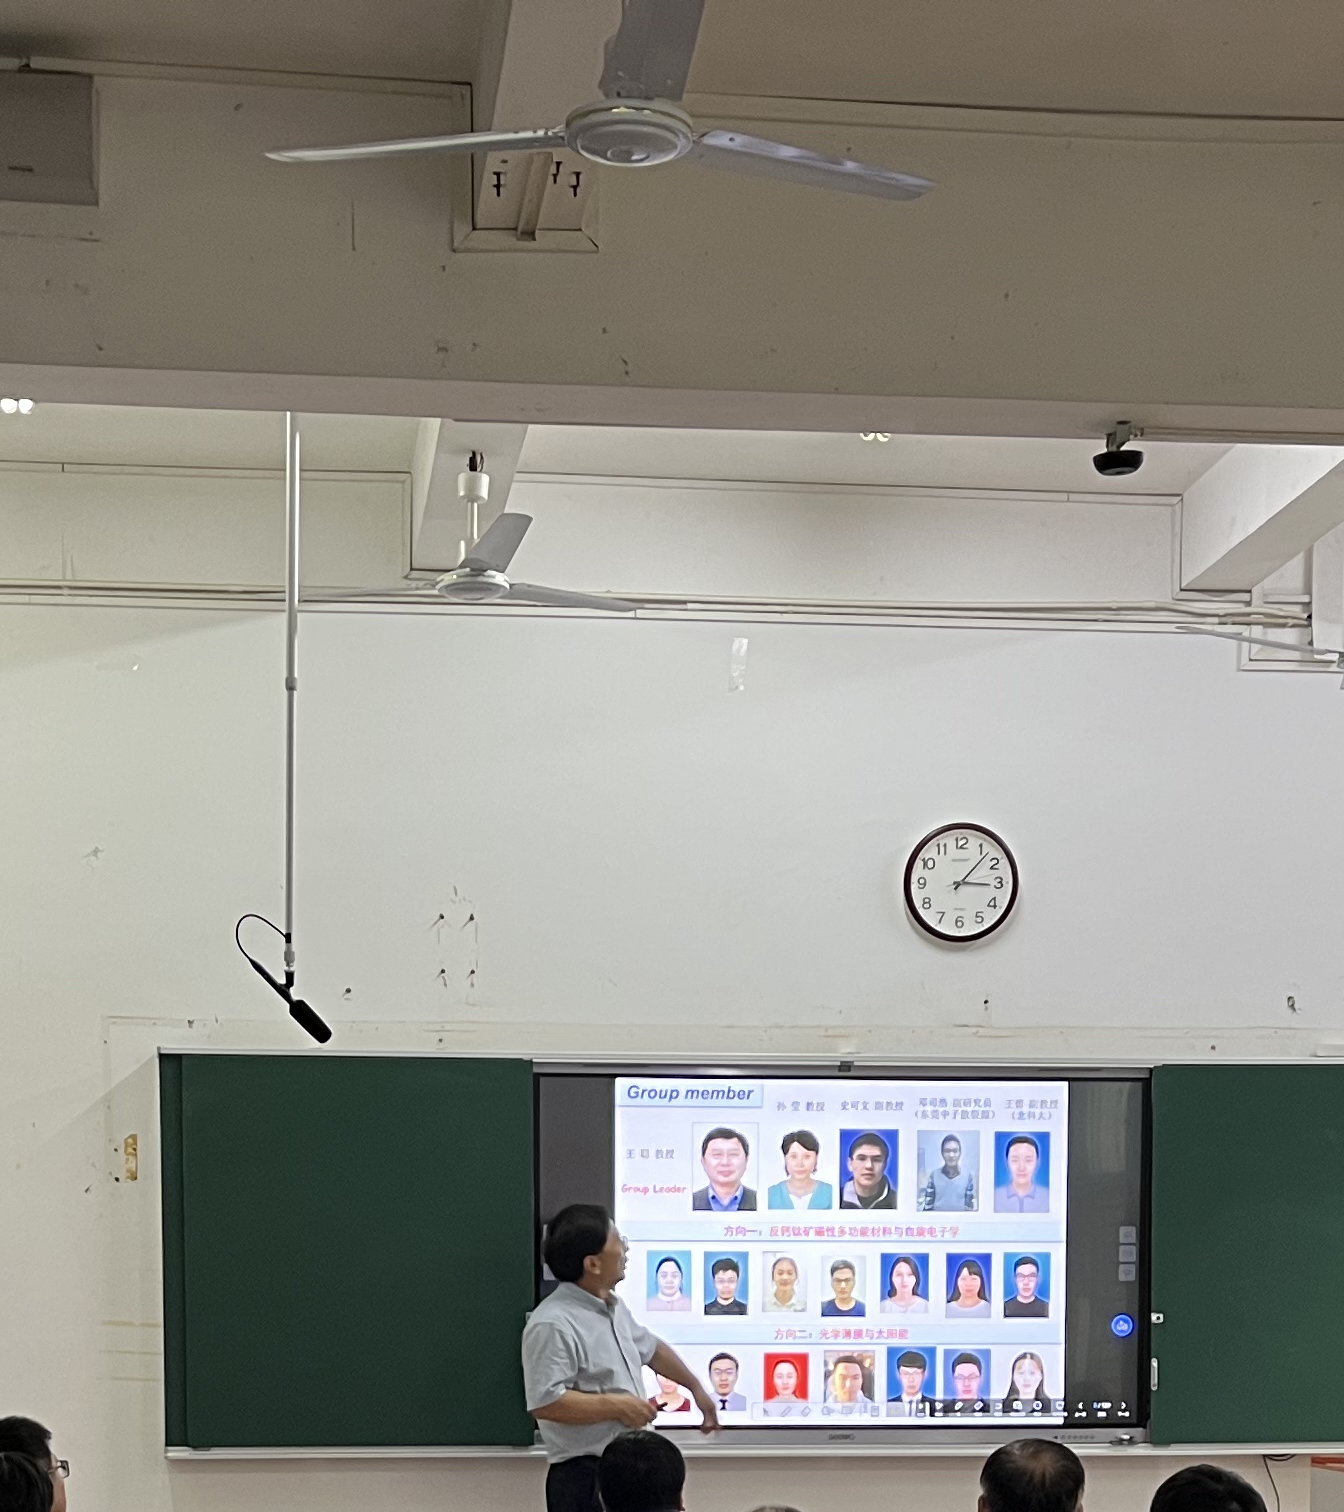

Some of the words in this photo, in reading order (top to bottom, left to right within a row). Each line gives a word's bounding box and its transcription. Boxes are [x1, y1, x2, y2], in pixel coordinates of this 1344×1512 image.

[936, 843, 947, 855] 11
[955, 836, 969, 850] 12
[978, 843, 983, 855] 1
[921, 857, 936, 870] 10
[989, 857, 1000, 870] 2
[917, 877, 927, 889] 9
[993, 876, 1004, 889] 3
[922, 897, 932, 909] 8
[987, 896, 997, 909] 4
[936, 911, 946, 924] 7
[955, 916, 964, 928] 6
[974, 911, 984, 924] 5
[627, 1085, 679, 1102] Group
[684, 1086, 754, 1100] member
[621, 1184, 649, 1195] Group
[653, 1184, 687, 1194] Leader
